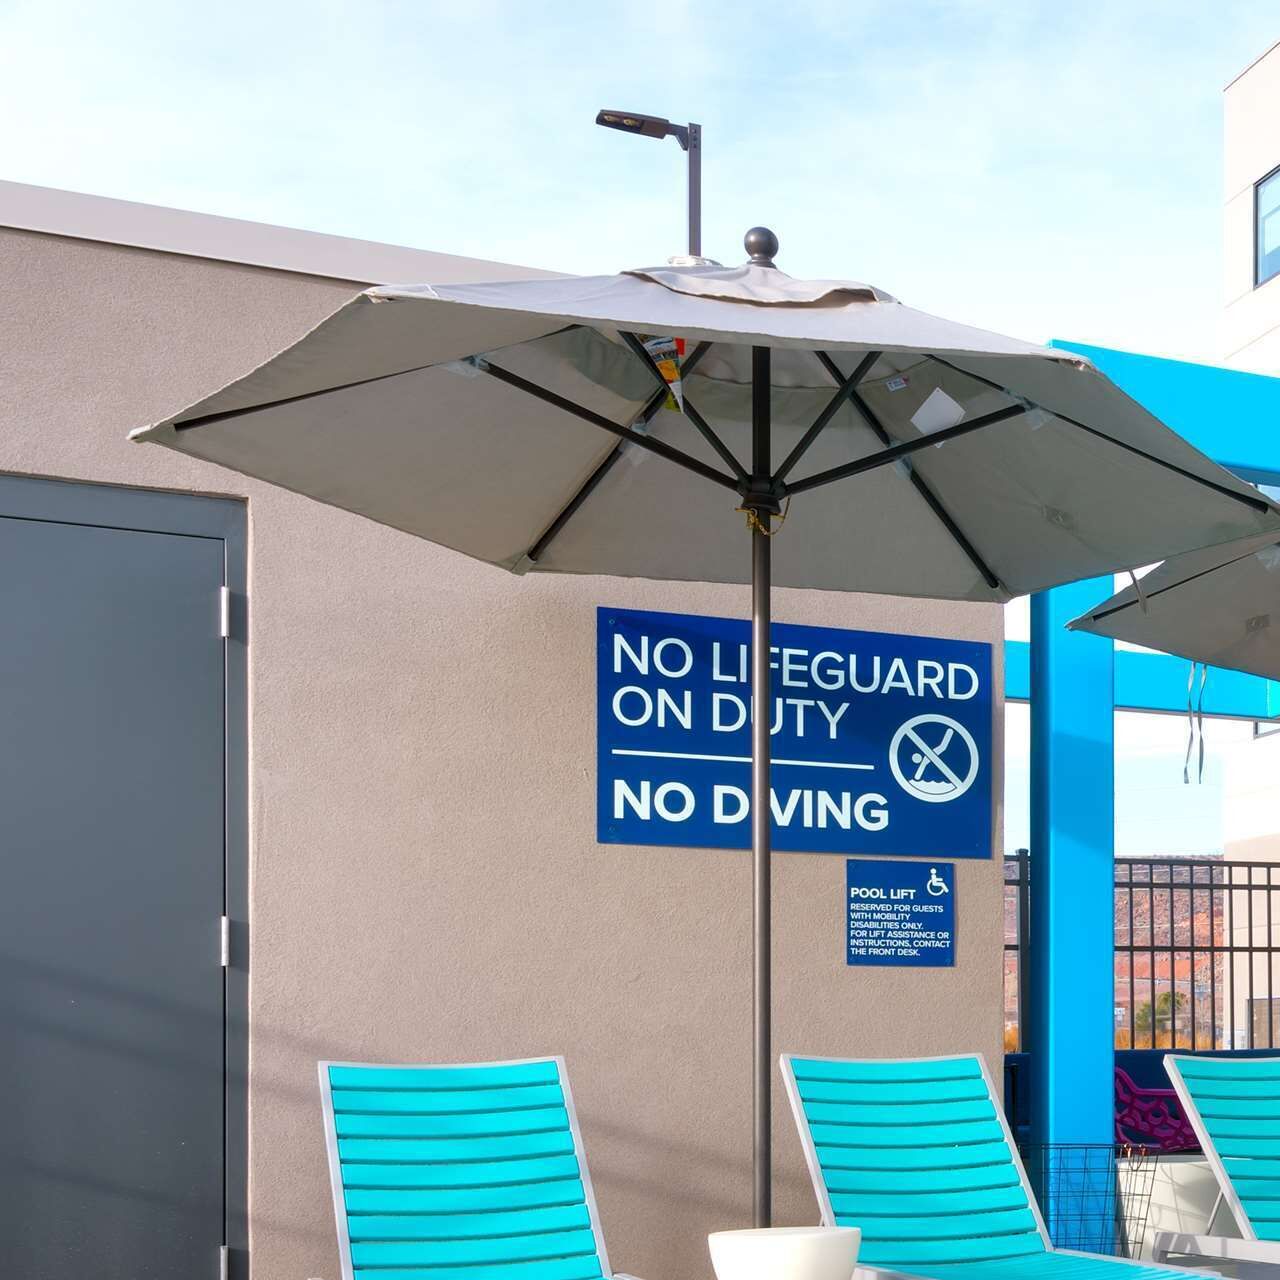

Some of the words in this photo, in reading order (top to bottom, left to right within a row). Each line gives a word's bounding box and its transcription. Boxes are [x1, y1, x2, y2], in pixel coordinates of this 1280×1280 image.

[613, 634, 693, 678] NO
[612, 685, 692, 730] ON
[613, 779, 696, 822] NO
[713, 785, 889, 832] DVING
[850, 887, 887, 899] POOL
[890, 888, 916, 900] LIFT
[850, 903, 892, 911] RESERVED
[894, 904, 911, 912] FOR
[912, 905, 944, 913] GUESTS
[850, 912, 871, 920] WITH
[873, 913, 911, 921] MOBILITY
[850, 921, 900, 929] DISABILITIES
[901, 922, 924, 930] ONLY.
[850, 930, 868, 938] FOR
[887, 931, 936, 939] ASSISTANCE
[937, 931, 950, 939] OR
[850, 939, 912, 948] INSTRUCTIONS,
[913, 940, 951, 948] CONTACT
[868, 948, 896, 956] FRONT
[897, 948, 921, 957] DESK.
